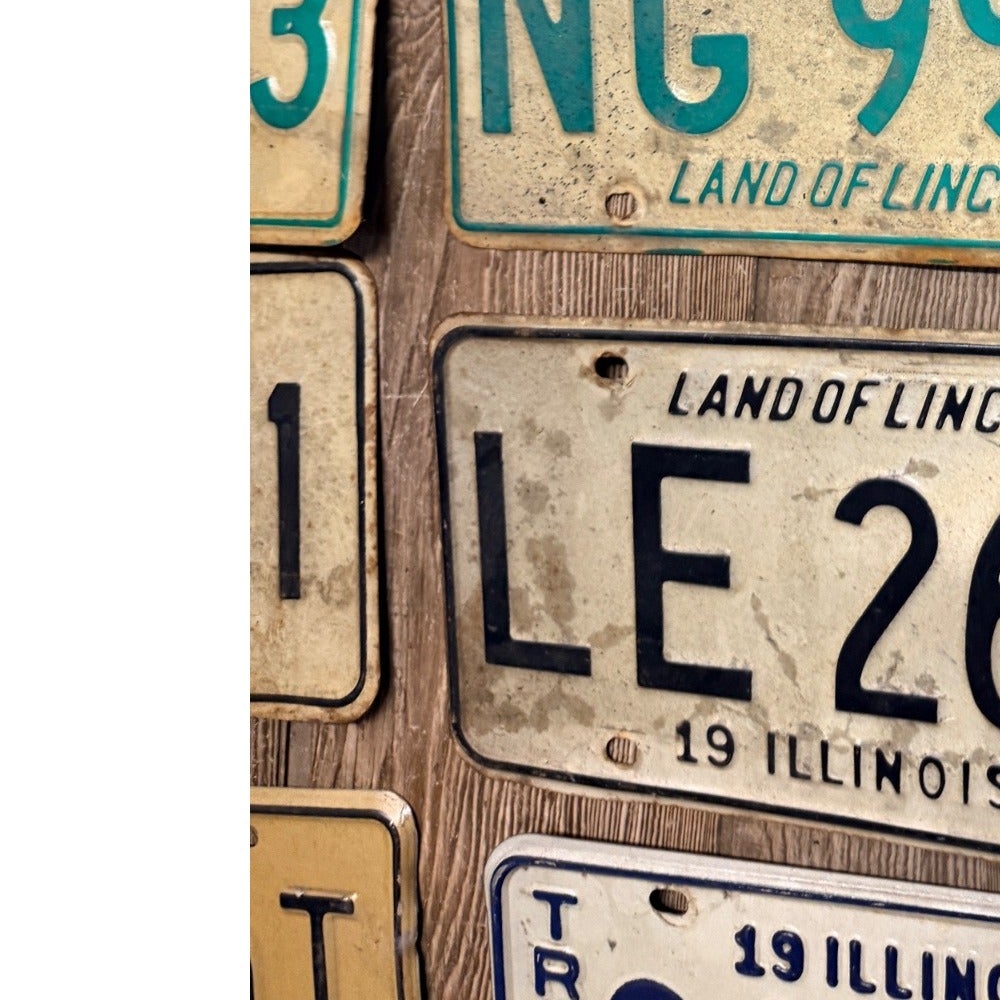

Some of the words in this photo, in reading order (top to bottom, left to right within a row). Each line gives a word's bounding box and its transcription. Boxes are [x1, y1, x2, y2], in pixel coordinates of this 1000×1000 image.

[668, 160, 799, 207] LAND
[809, 162, 879, 209] OF
[668, 370, 803, 422] LAND
[811, 377, 881, 425] OF
[267, 382, 302, 600] 1
[472, 430, 752, 701] LE
[675, 719, 736, 768] 19
[250, 891, 356, 1000] T
[734, 923, 805, 983] 19
